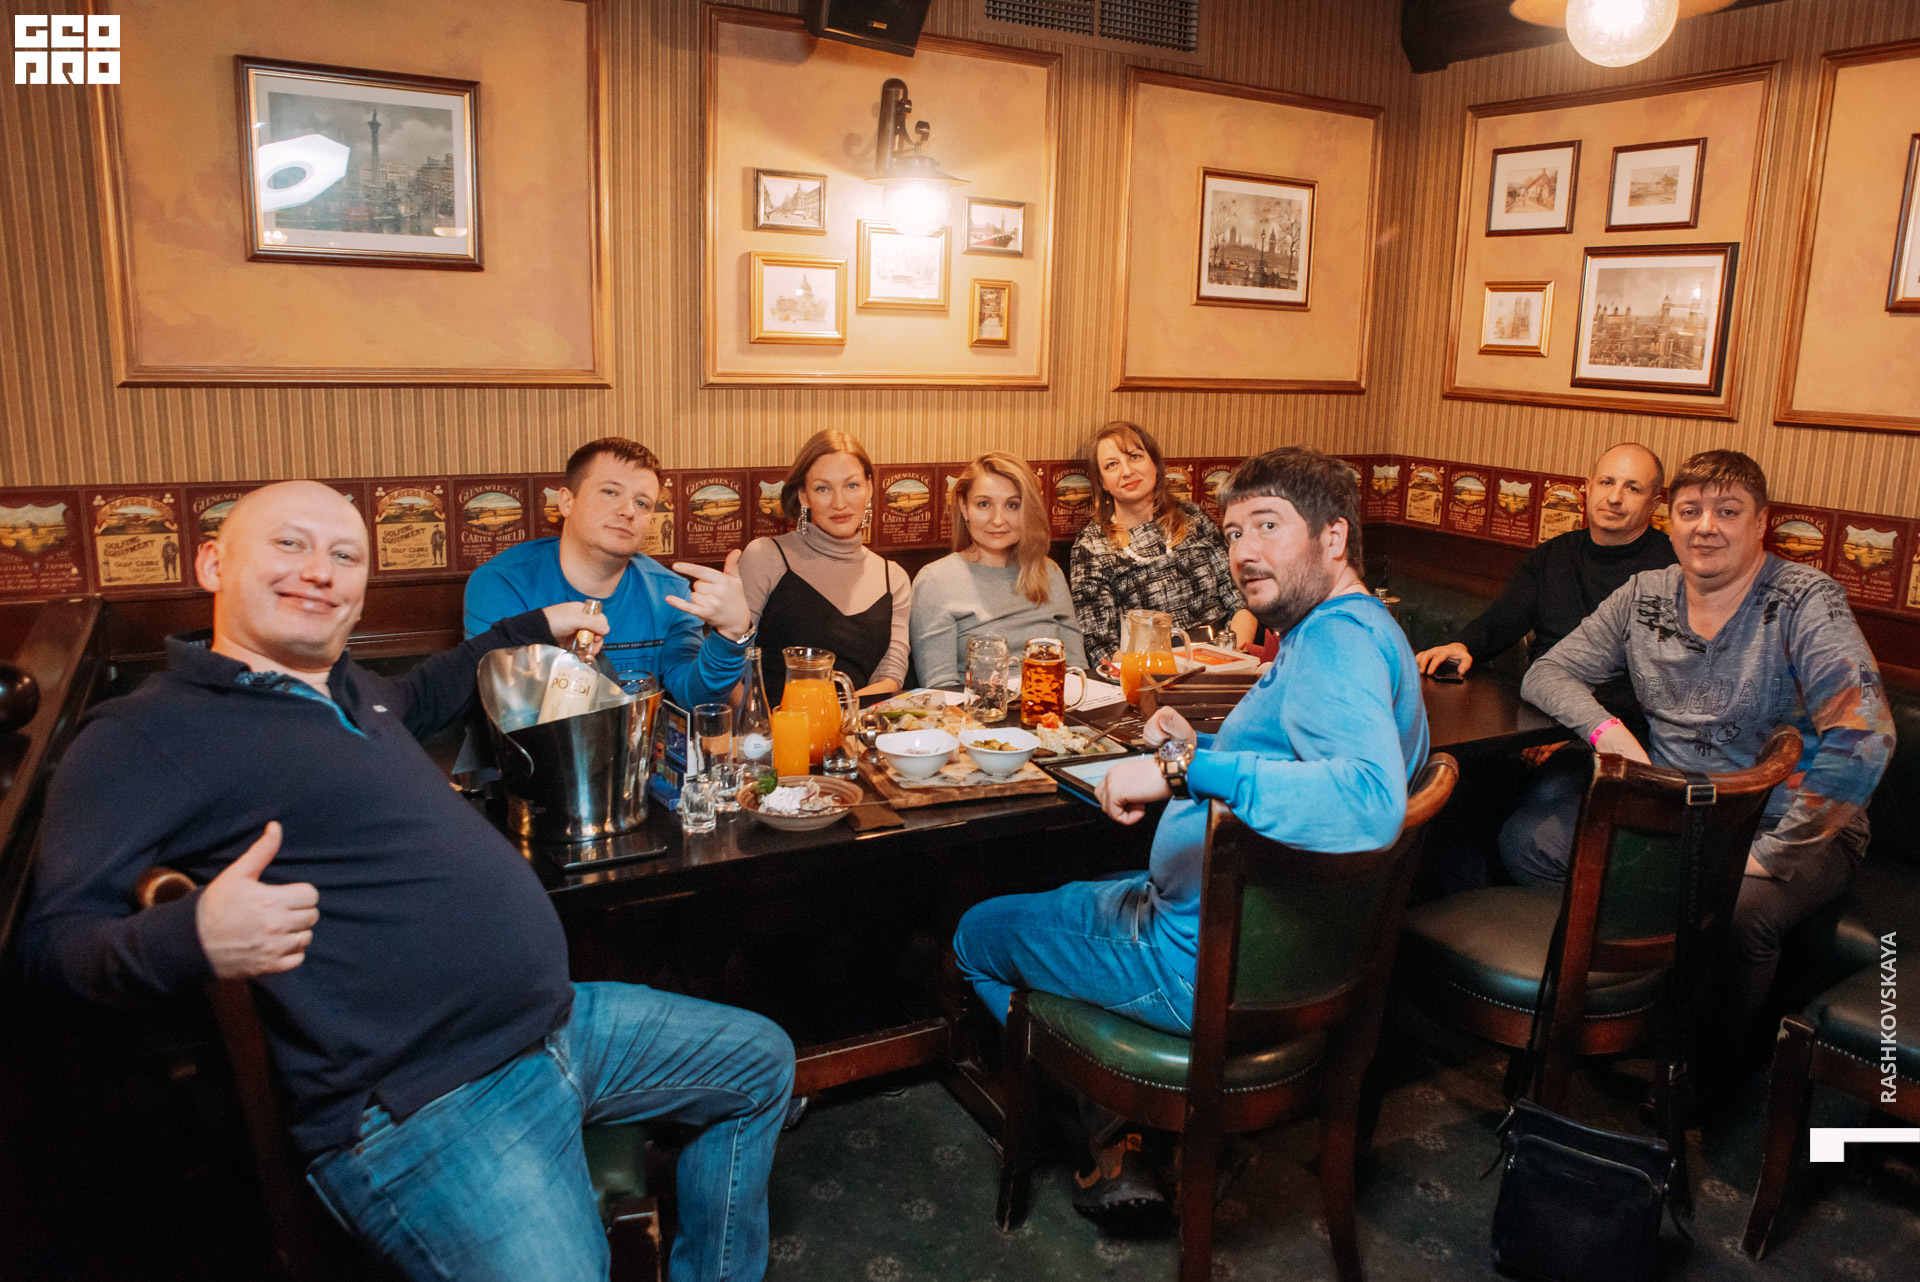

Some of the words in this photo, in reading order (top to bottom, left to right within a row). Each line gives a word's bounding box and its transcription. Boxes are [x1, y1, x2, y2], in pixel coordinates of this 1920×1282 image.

[686, 478, 729, 496] GLENEAGLES
[882, 472, 920, 489] GLENEAGLES
[458, 485, 508, 504] GLENEAGLES
[193, 492, 244, 513] GLENEAGLE
[882, 512, 906, 523] CARTER
[908, 511, 931, 522] SHIELD
[1771, 514, 1814, 527] GLENEAGLES
[384, 524, 413, 537] GOLFING
[687, 520, 714, 532] CARTER
[717, 520, 743, 531] SHIELD
[105, 536, 140, 549] GOLFING
[382, 528, 426, 544] EQUIPMENT
[461, 531, 492, 543] CARTER
[496, 529, 526, 541] SHIELD
[104, 540, 155, 558] EQUIPMENT
